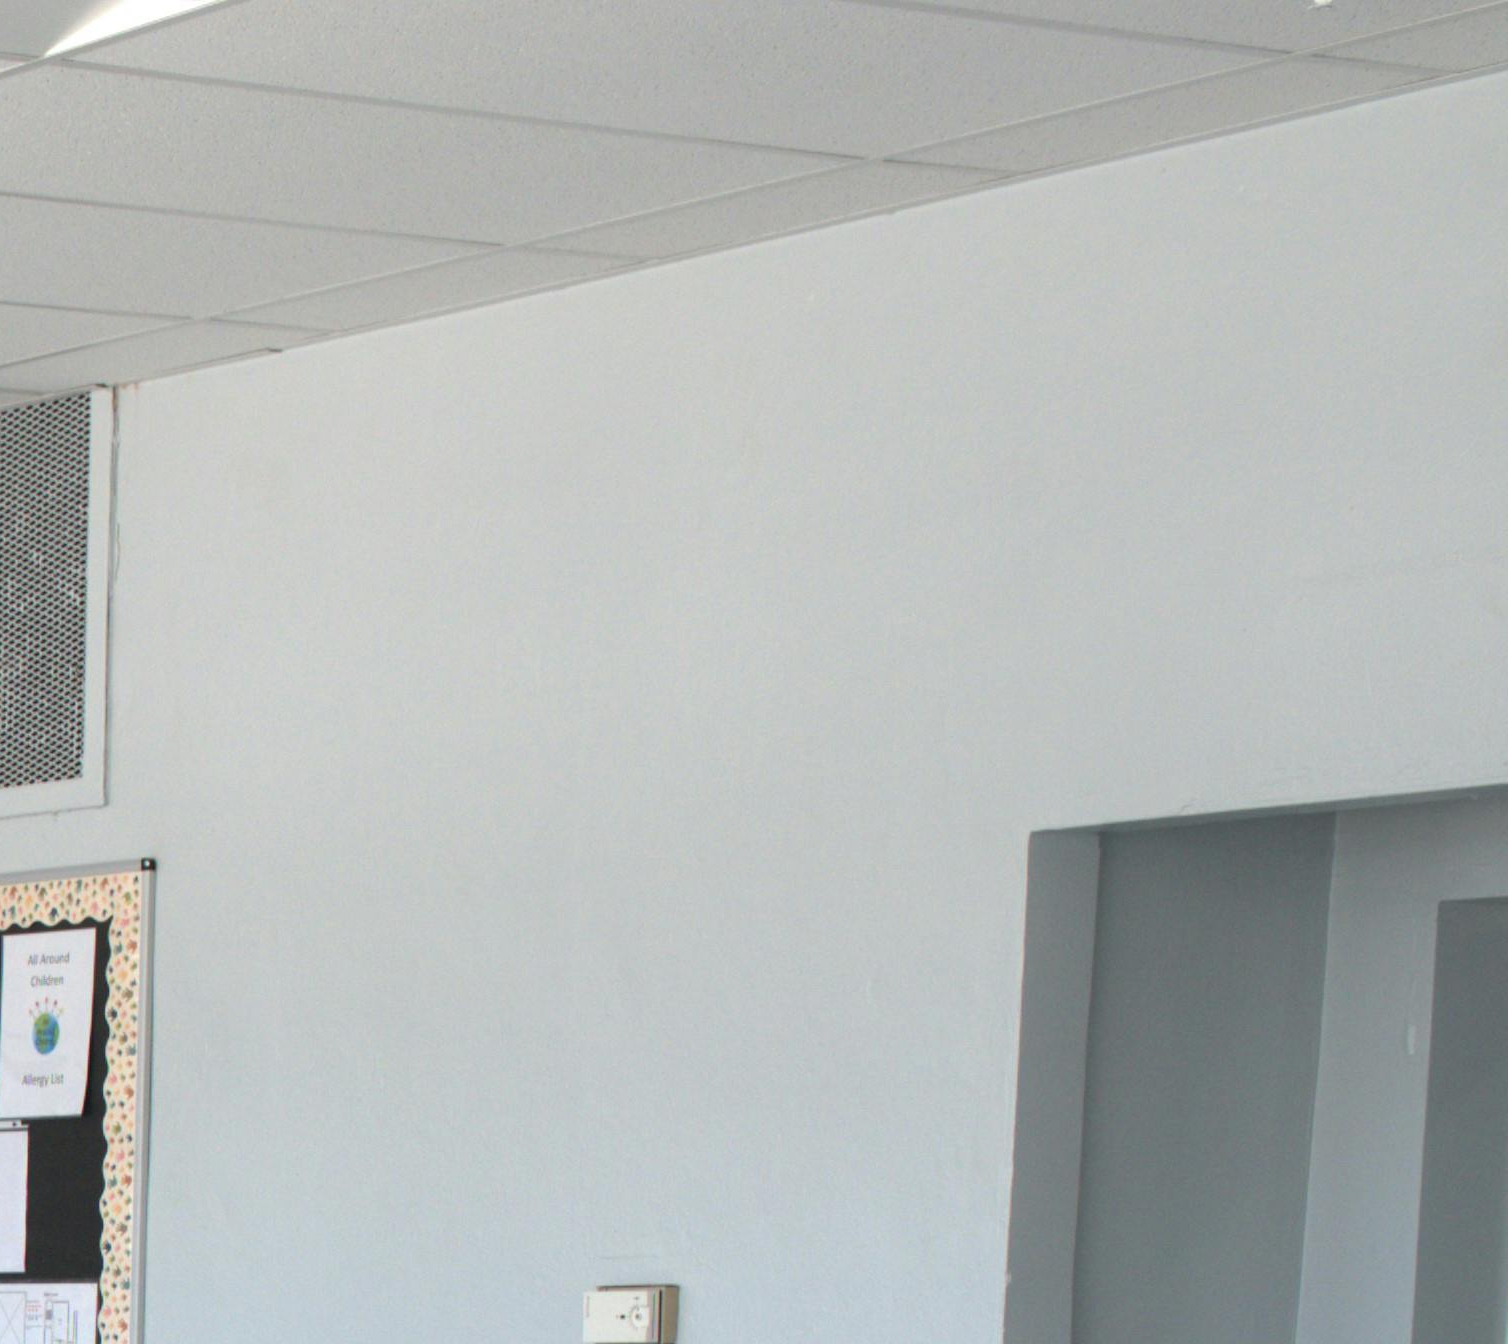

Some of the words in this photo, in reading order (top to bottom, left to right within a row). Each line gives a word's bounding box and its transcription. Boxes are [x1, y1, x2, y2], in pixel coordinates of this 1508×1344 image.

[28, 955, 38, 965] All
[40, 953, 70, 964] Around
[31, 976, 64, 987] Children
[22, 1074, 49, 1088] Allergy
[51, 1074, 64, 1085] List
